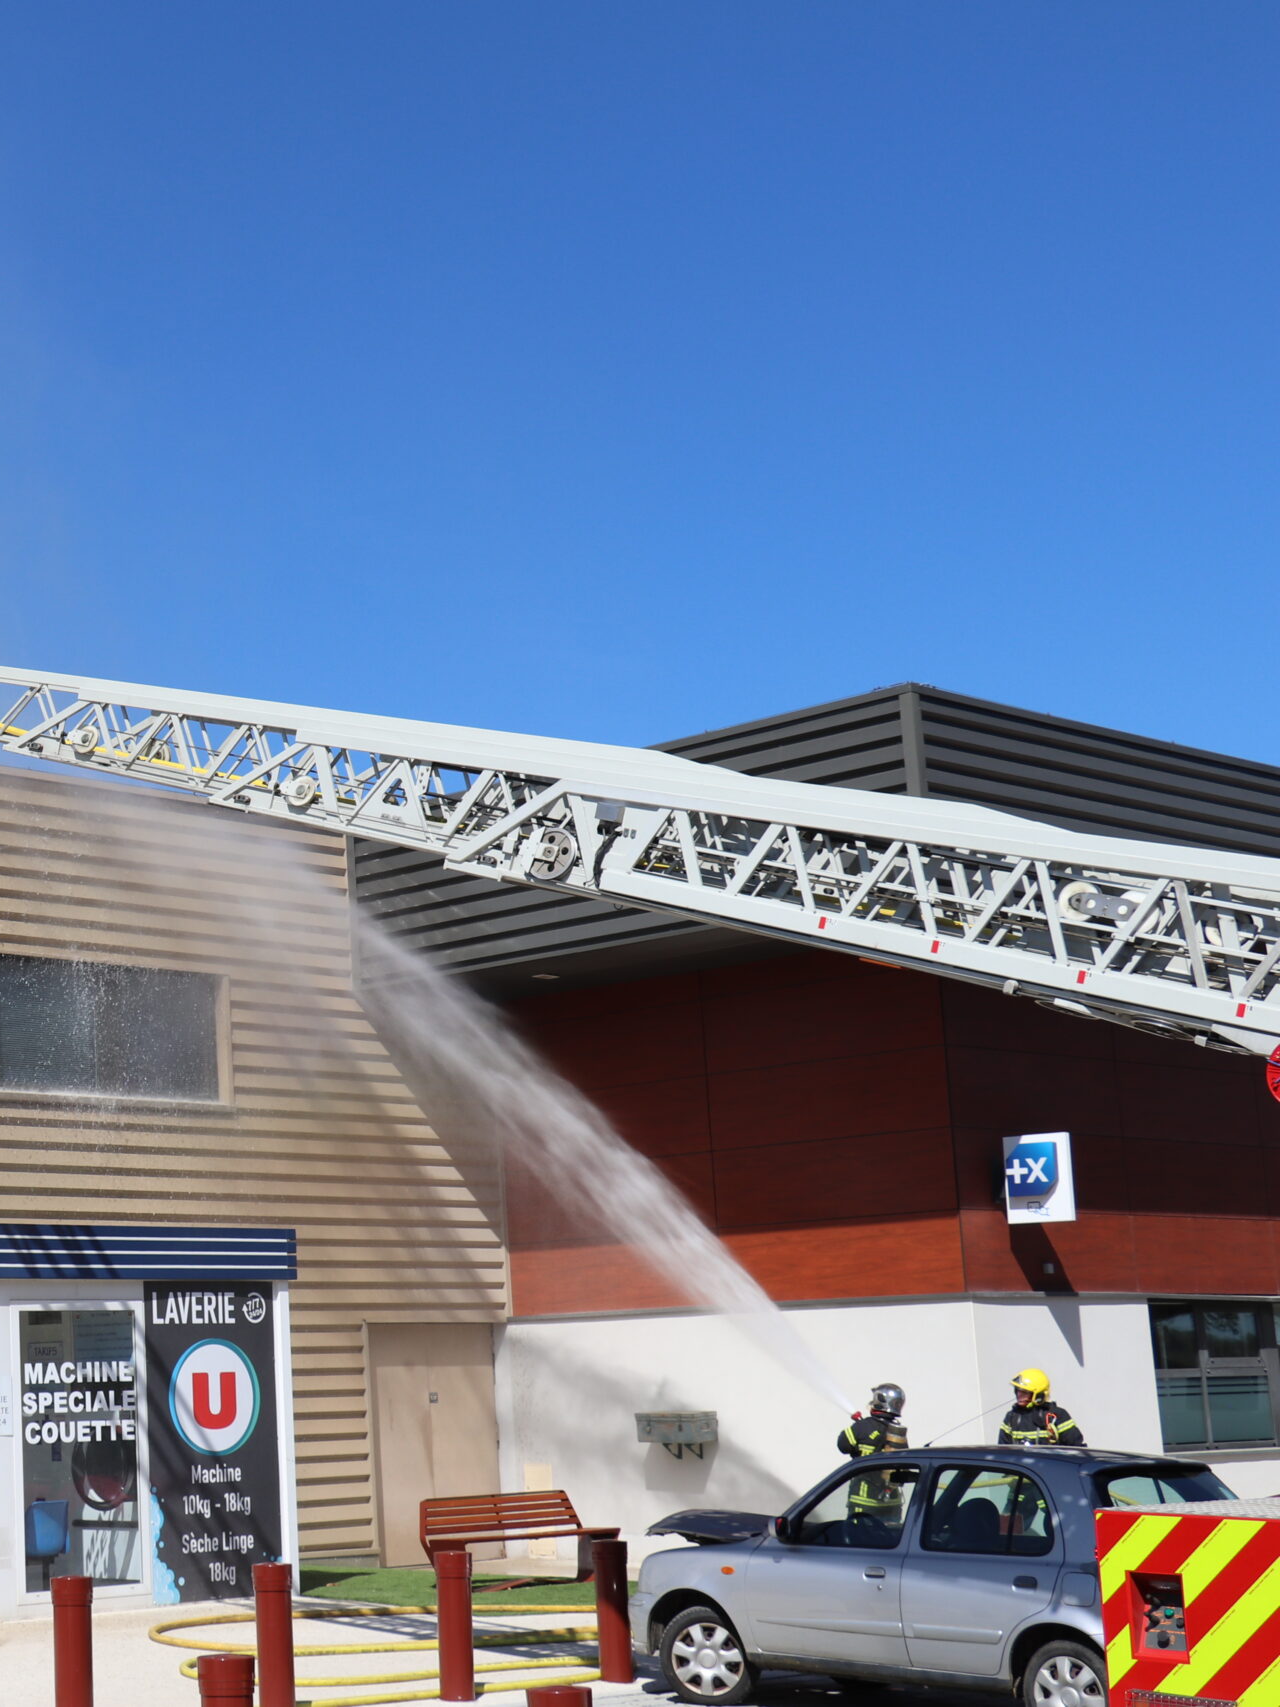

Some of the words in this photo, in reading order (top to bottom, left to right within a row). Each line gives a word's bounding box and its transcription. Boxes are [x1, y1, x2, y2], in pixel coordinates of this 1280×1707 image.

[152, 1292, 236, 1324] LAVERIE
[24, 1361, 134, 1384] MACHINE
[22, 1390, 136, 1414] SPECIALE
[192, 1372, 237, 1430] U
[24, 1419, 136, 1444] COUETTE
[192, 1464, 242, 1484] Machine
[182, 1494, 211, 1518] 10kg
[224, 1492, 252, 1516] 18kg
[182, 1532, 219, 1554] Sèche
[222, 1532, 254, 1554] Linge
[209, 1562, 236, 1585] 18kg
